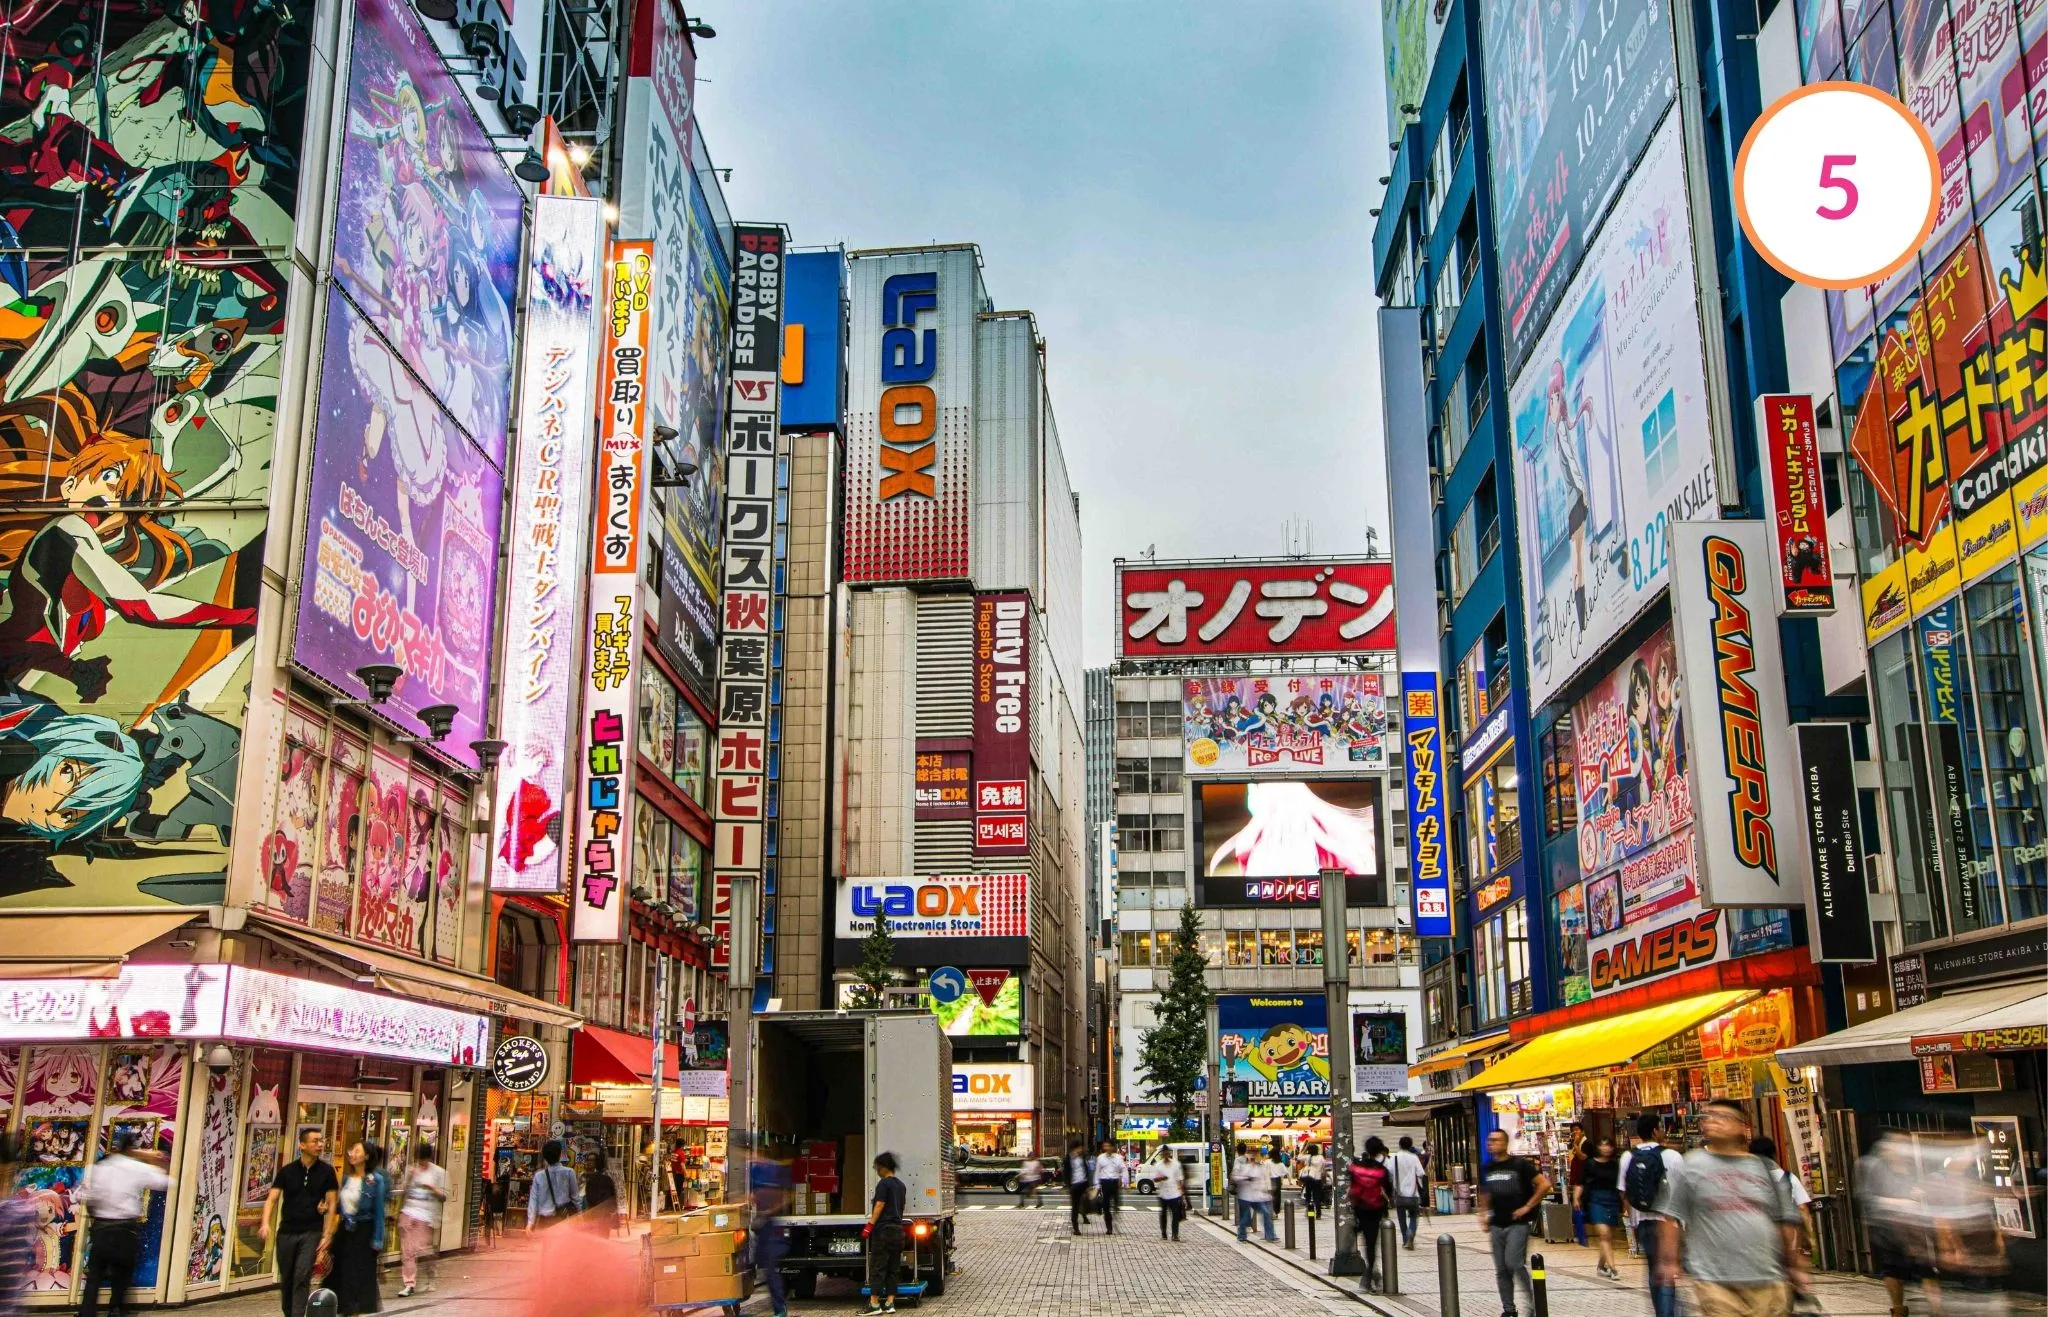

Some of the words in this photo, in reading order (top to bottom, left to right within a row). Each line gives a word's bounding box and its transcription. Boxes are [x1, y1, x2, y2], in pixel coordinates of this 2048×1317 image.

[1575, 44, 1625, 167] 10.21
[612, 262, 632, 338] 買います
[633, 255, 650, 311] DVD
[735, 235, 759, 365] PARADISE
[757, 235, 781, 322] HOBBY
[1641, 258, 1683, 323] Collection
[612, 347, 642, 426] 買取り
[1684, 463, 1714, 512] SALE
[1782, 417, 1809, 534] カードキングダム
[605, 464, 635, 561] まっくす
[1126, 566, 1394, 643] オノデン
[592, 612, 614, 692] 買います
[978, 602, 993, 660] Flagship
[993, 601, 1025, 665] Duty
[981, 664, 993, 703] Store
[996, 671, 1025, 734] Free
[1409, 693, 1433, 716] 薬
[1706, 535, 1780, 887] GAMERS
[916, 755, 942, 768] 本店
[916, 768, 968, 782] 総合家電
[1294, 748, 1322, 763] LIVE
[1610, 748, 1630, 775] LIVE
[980, 785, 1022, 806] 免税
[1810, 766, 1822, 800] AKIBA
[584, 708, 624, 910] とれじゃらす
[1602, 771, 1694, 861] ゲームアプリ登
[1817, 801, 1828, 844] STORE
[1842, 809, 1850, 828] Site
[980, 823, 1024, 840] 면세점
[1845, 827, 1853, 849] Real
[1815, 847, 1835, 918] ALIENWARE
[1847, 850, 1856, 873] Dell
[1249, 883, 1318, 895] ANIPLE
[850, 920, 877, 932] Hom
[950, 919, 981, 930] Store
[1591, 909, 1721, 993] GAMERS
[1934, 955, 1976, 971] ALIENWARE
[1978, 950, 2004, 964] STORE
[2006, 945, 2032, 958] AKIBA
[976, 976, 1001, 986] 止まれ
[1250, 999, 1292, 1007] Welcome
[1293, 999, 1304, 1007] to
[499, 1040, 542, 1058] SMOKER'S
[497, 1069, 513, 1088] VAPE
[514, 1071, 541, 1089] STAND
[1249, 1080, 1331, 1096] IHABAR
